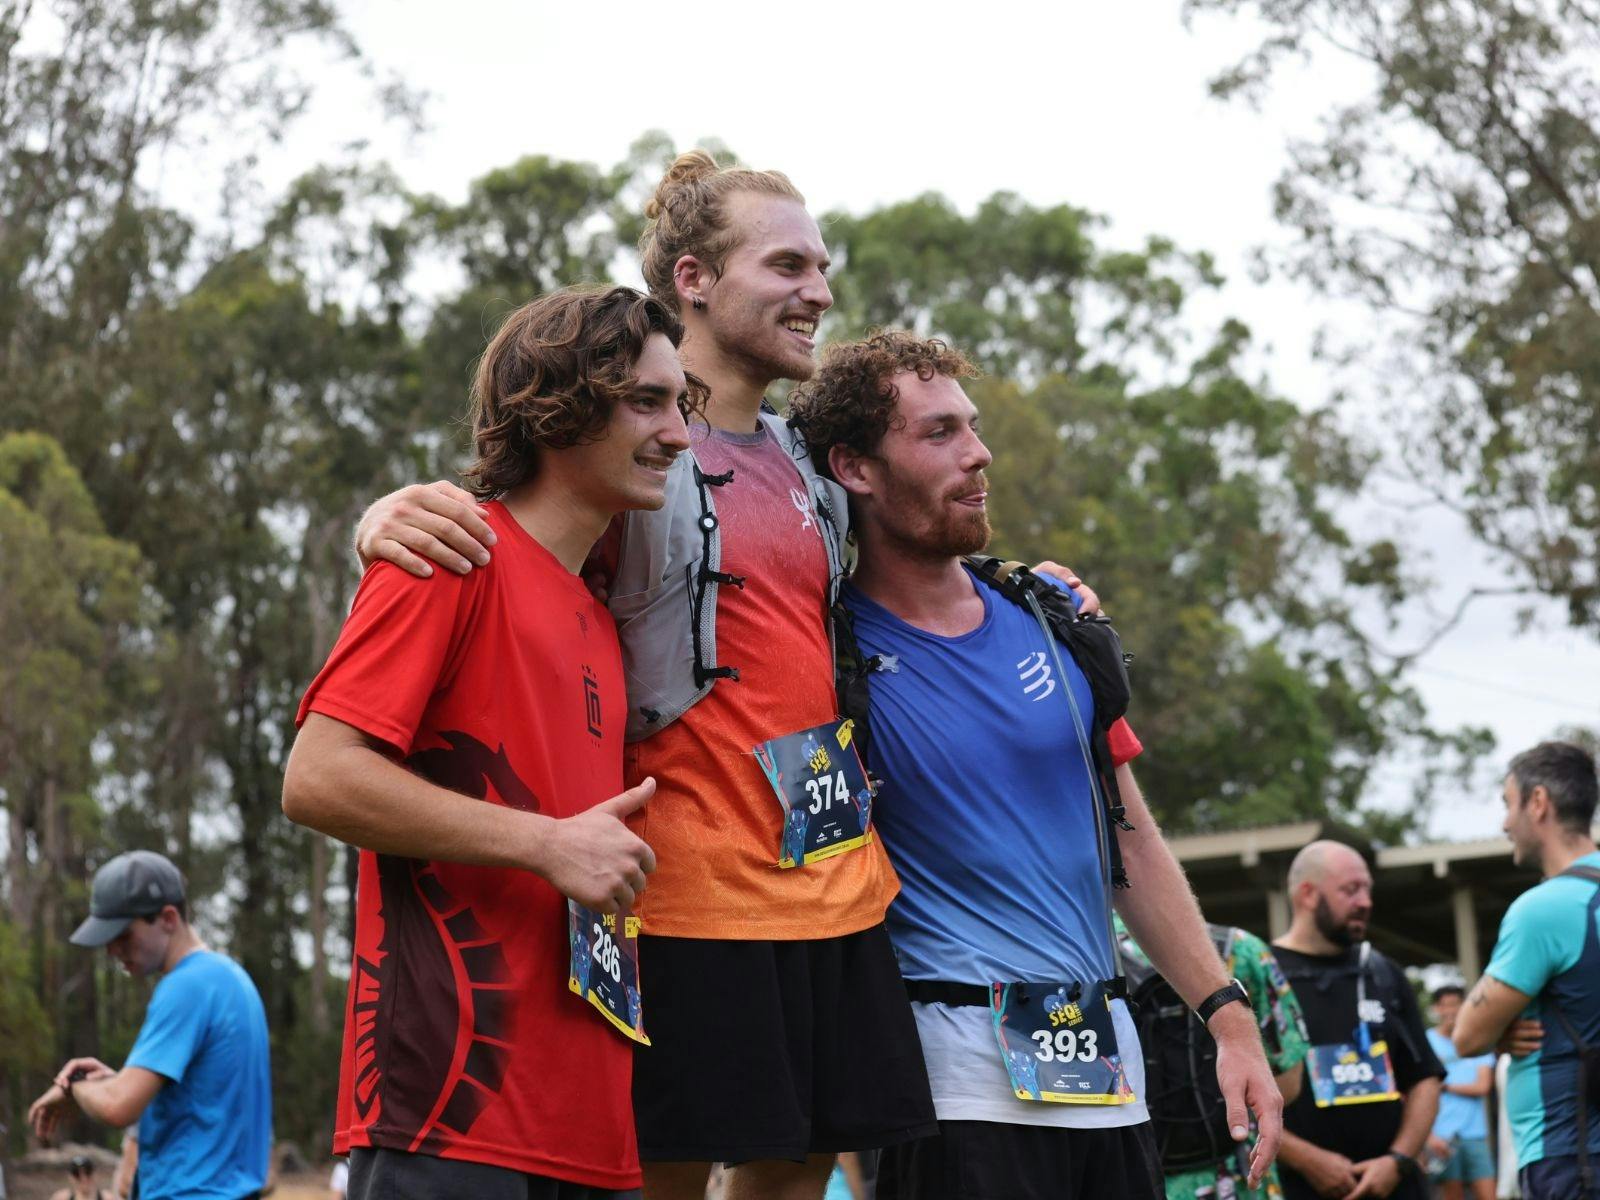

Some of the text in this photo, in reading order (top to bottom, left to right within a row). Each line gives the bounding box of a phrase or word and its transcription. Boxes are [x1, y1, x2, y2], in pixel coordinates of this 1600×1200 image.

[805, 770, 850, 815] 374
[592, 922, 621, 983] 286
[1049, 1004, 1077, 1027] SEQ
[1031, 1029, 1098, 1063] 393
